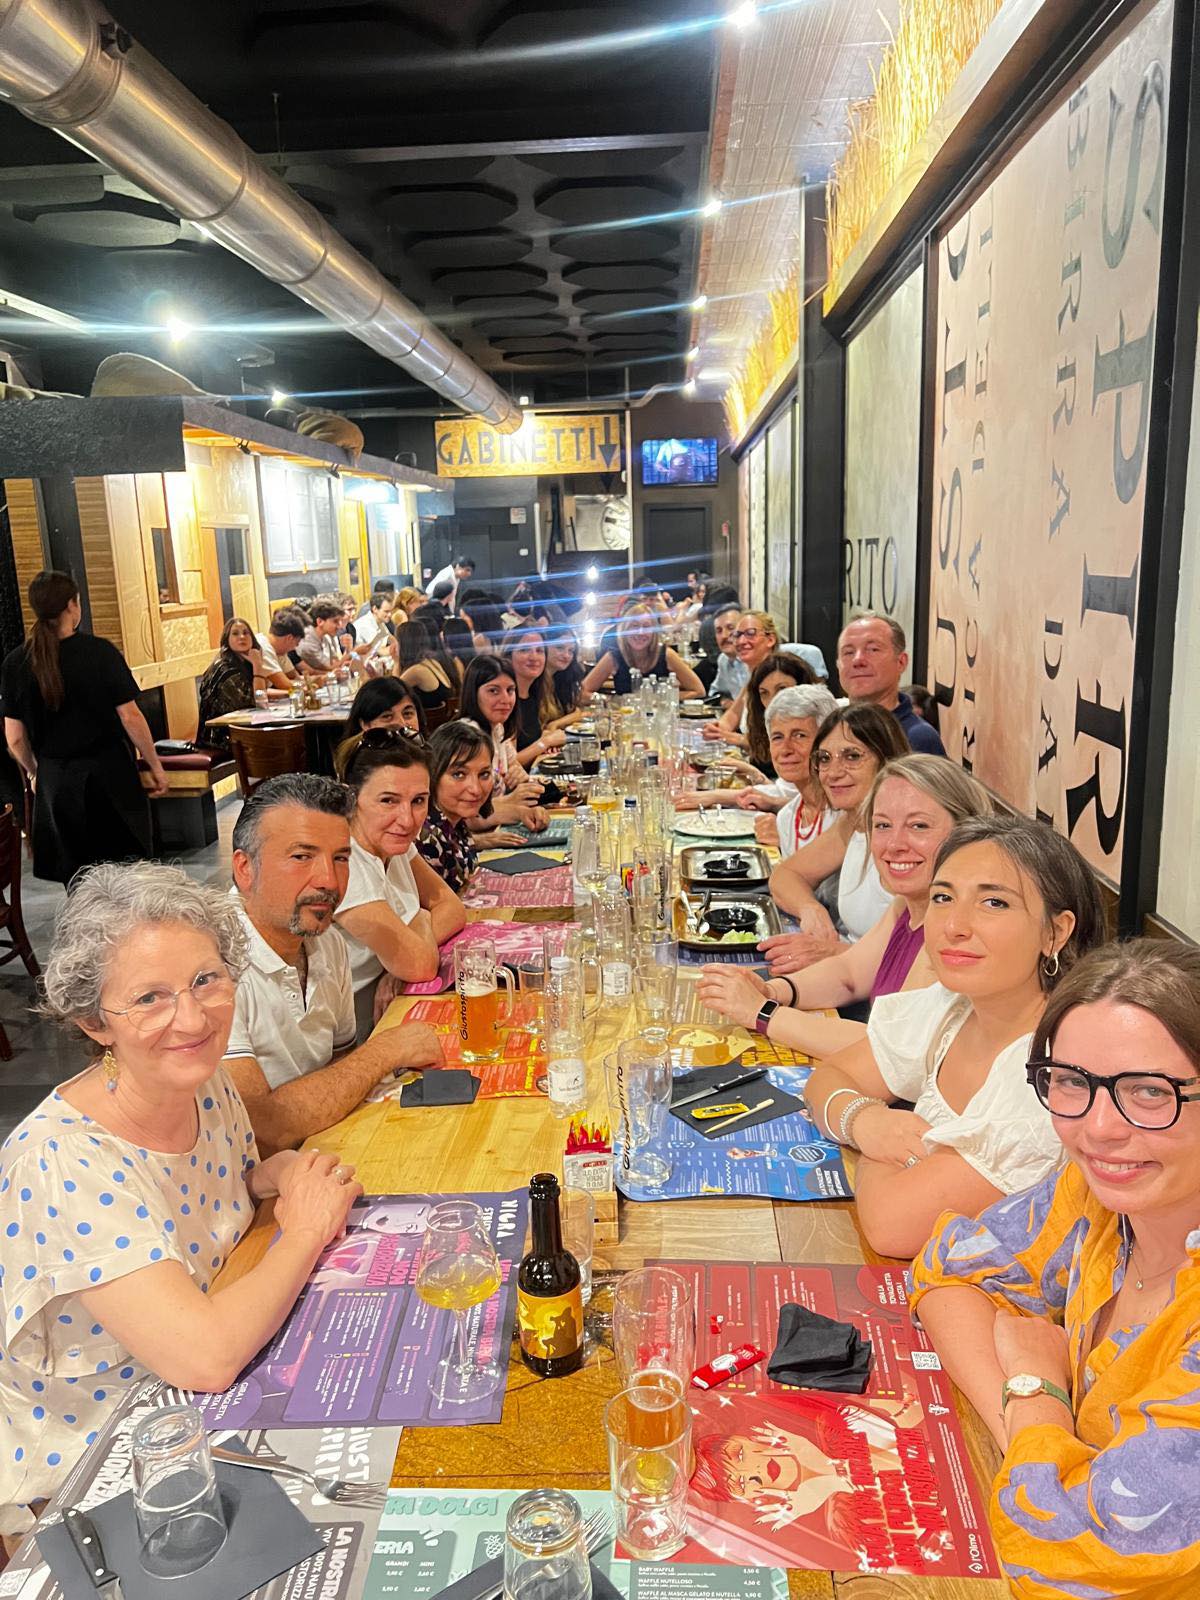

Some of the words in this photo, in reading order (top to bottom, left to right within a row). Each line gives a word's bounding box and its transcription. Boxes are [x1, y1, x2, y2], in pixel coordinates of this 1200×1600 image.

[1049, 84, 1088, 542] BIRRA
[437, 427, 595, 465] GABINETTI
[459, 970, 468, 1041] Giustospirito
[418, 1496, 499, 1516] DOLCI
[335, 1527, 354, 1546] LA
